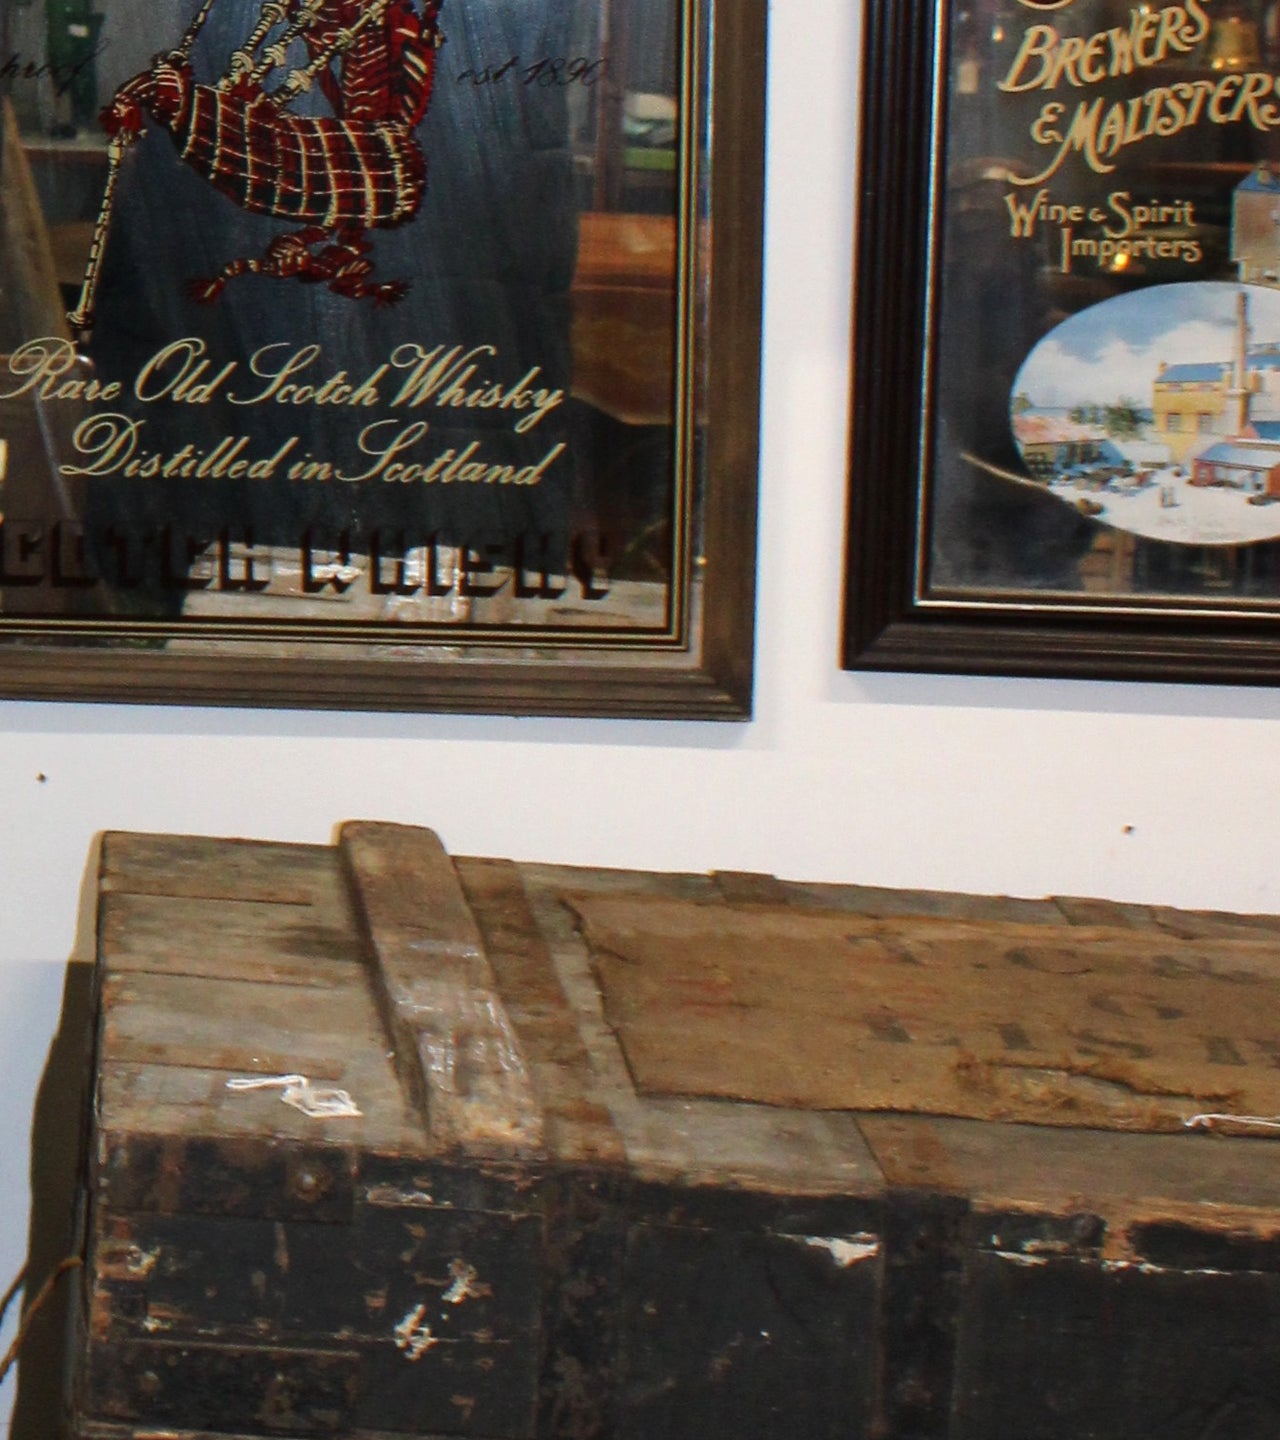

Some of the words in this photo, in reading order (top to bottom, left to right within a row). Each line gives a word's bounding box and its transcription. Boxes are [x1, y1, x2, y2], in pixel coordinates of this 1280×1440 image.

[1003, 189, 1085, 238] Wine
[1103, 191, 1196, 239] Spirit
[1061, 227, 1203, 273] Importers
[135, 337, 236, 404] Old
[227, 342, 389, 409] Scotch
[389, 343, 564, 433] Whisky
[59, 412, 298, 480] Distilled
[286, 443, 333, 481] in
[334, 420, 566, 486] Scotland
